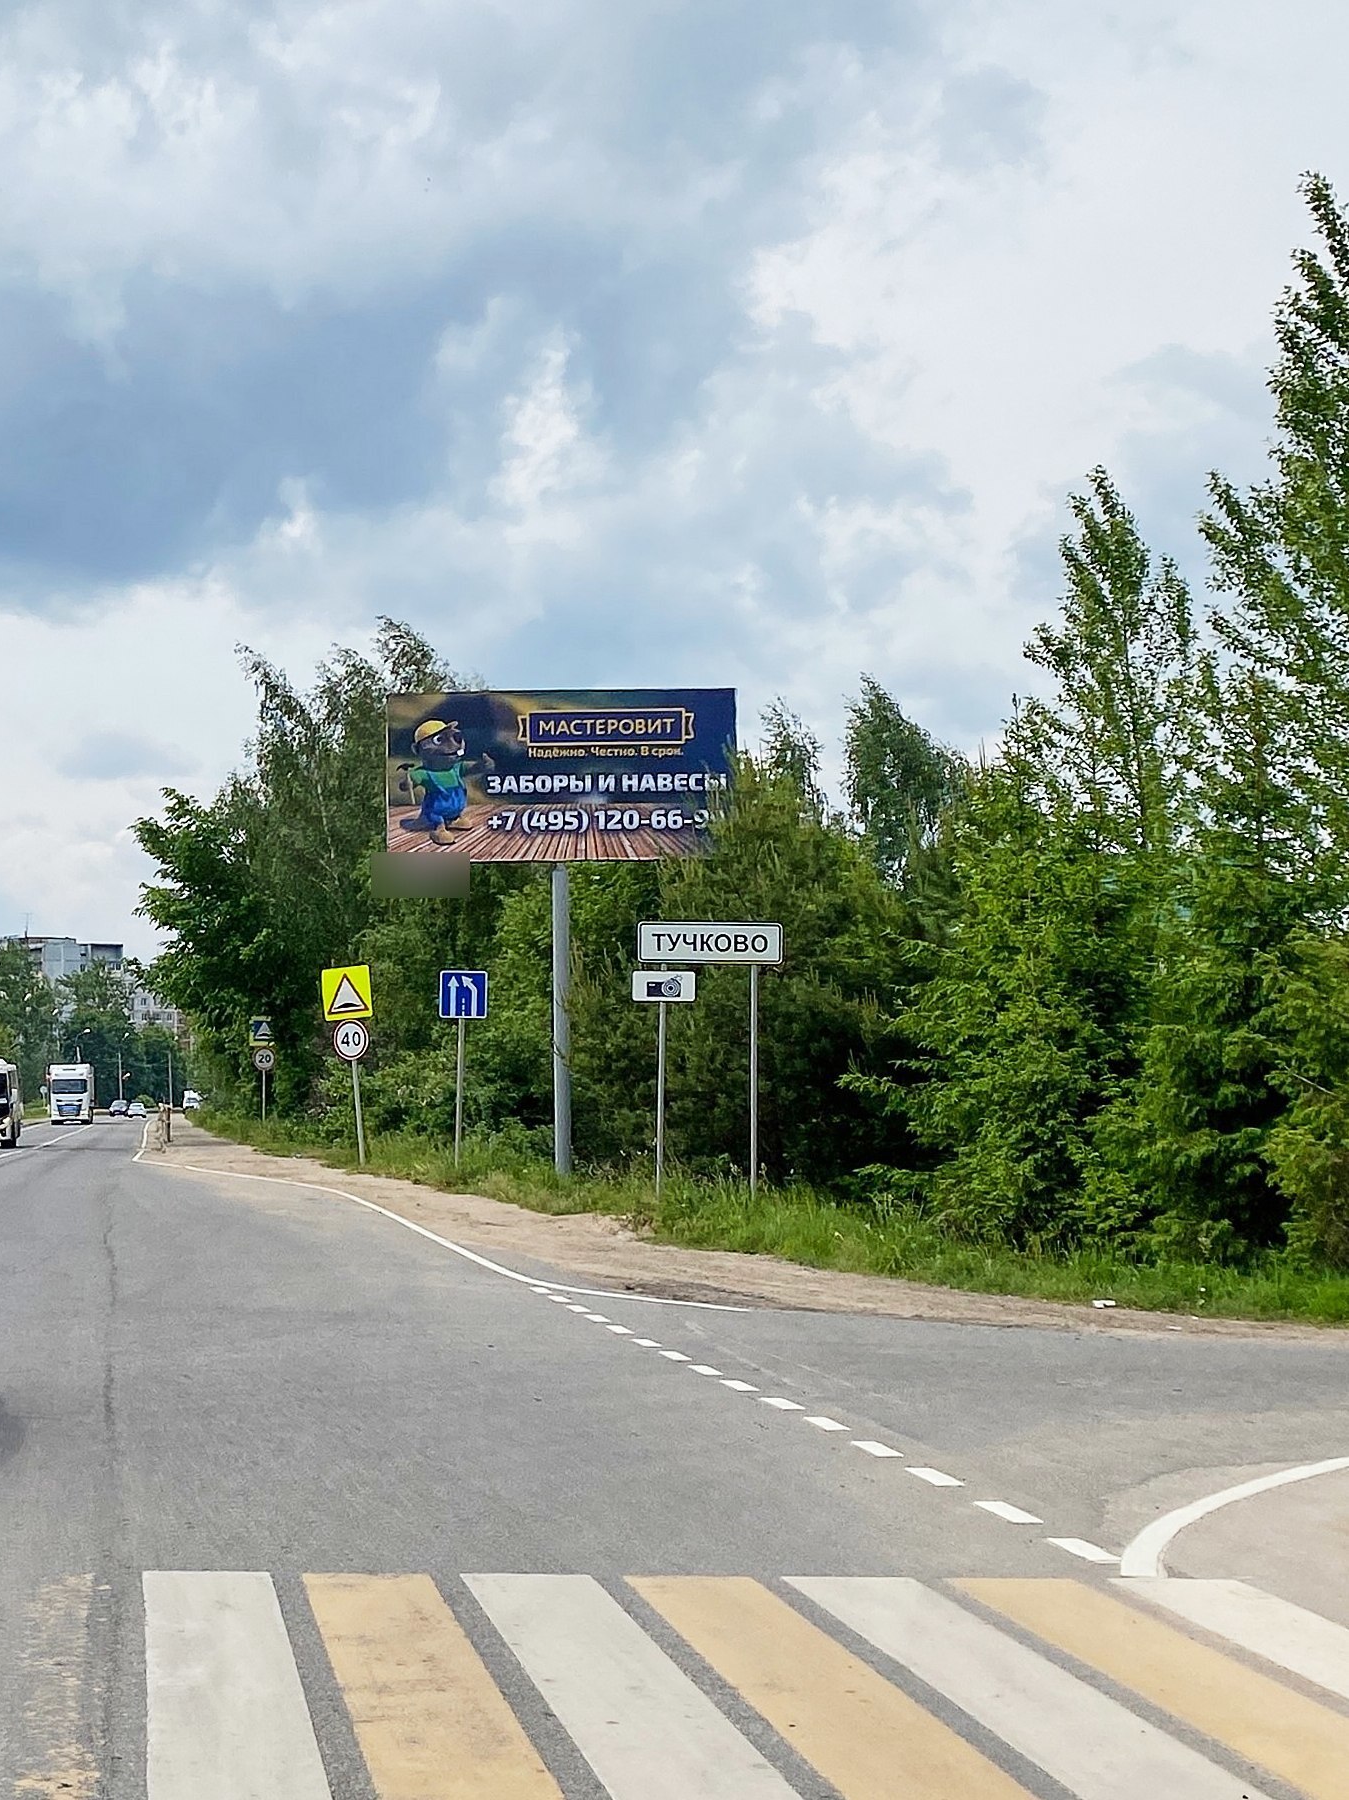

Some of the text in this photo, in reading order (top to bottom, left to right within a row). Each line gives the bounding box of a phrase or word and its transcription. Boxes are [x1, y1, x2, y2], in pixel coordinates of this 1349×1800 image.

[538, 718, 675, 736] МАСТЕРОВИТ
[528, 745, 684, 759] Надёжно. Честно. В срок.
[486, 774, 593, 794] ЗАБОРЫ
[598, 774, 616, 793] И
[487, 812, 516, 831] +7
[521, 809, 589, 834] (495)
[651, 933, 768, 953] ТУЧКОВО
[340, 1031, 361, 1047] 40
[258, 1054, 271, 1064] 20
